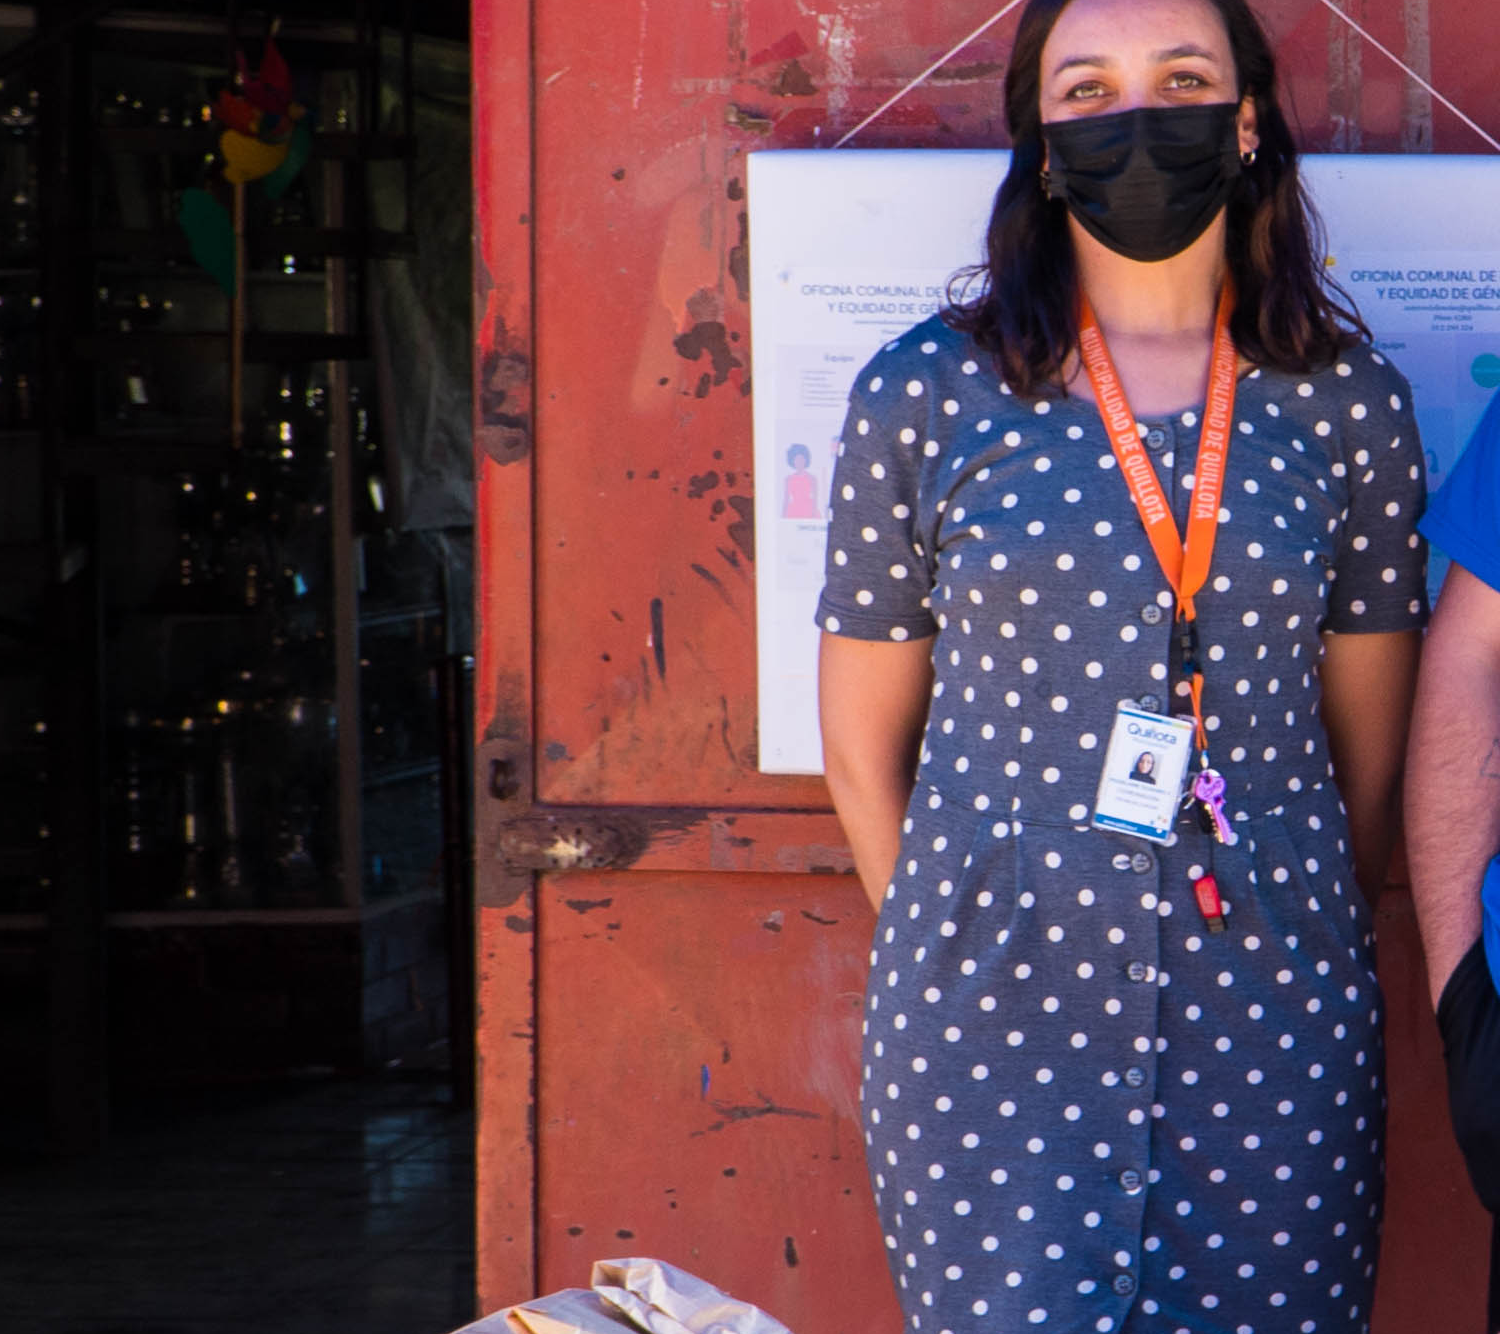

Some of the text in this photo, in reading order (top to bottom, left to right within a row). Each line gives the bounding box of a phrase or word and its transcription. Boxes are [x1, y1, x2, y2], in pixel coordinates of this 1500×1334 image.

[1350, 269, 1404, 283] OFICINA
[1408, 269, 1475, 283] COMUNAL
[1479, 269, 1497, 283] DE
[801, 284, 853, 297] OFICINA
[856, 285, 922, 297] COMUNAL
[1376, 287, 1385, 300] Y
[1388, 287, 1450, 301] EQUIDAD
[1452, 287, 1470, 300] DE
[827, 302, 836, 314] Y
[838, 302, 897, 315] EQUIDAD
[900, 302, 915, 315] DE
[1081, 325, 1167, 525] MUNICIPALIDAD DE QUILLOTA
[1205, 430, 1224, 451] DE
[1195, 451, 1222, 520] QUILLOTA
